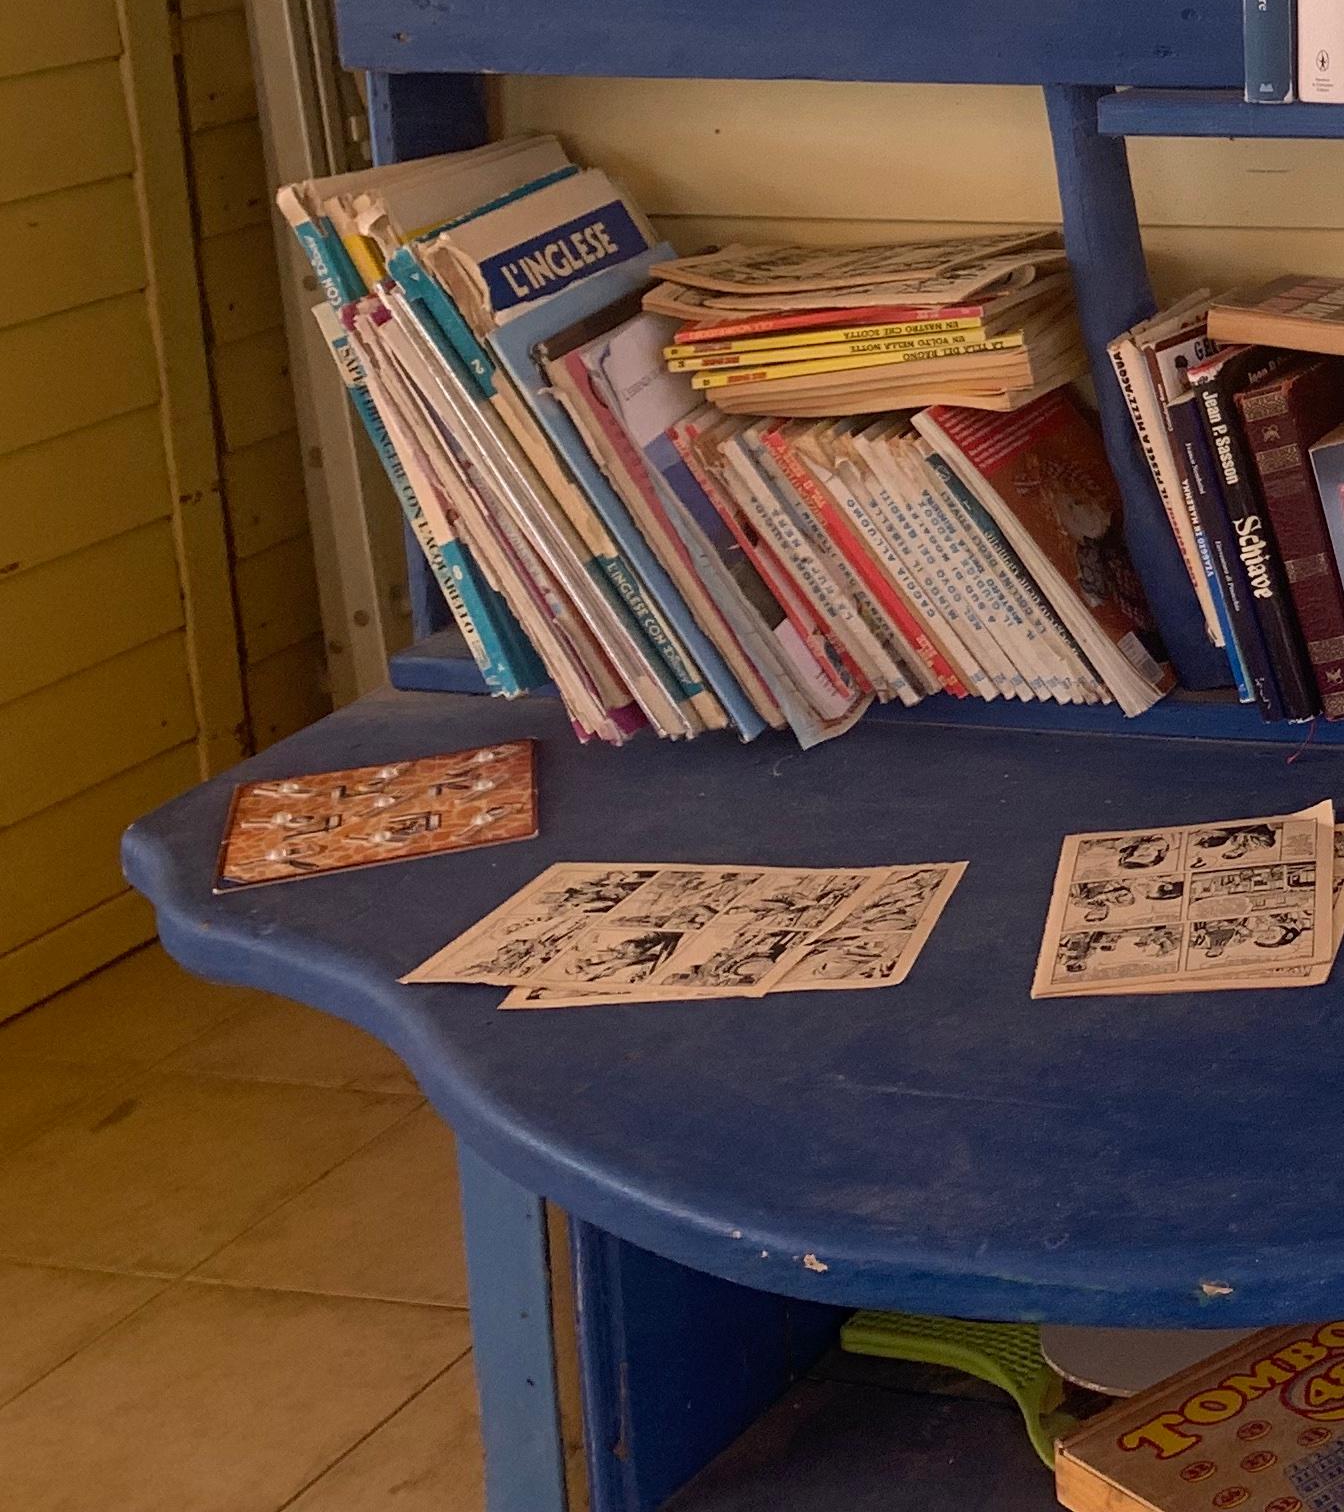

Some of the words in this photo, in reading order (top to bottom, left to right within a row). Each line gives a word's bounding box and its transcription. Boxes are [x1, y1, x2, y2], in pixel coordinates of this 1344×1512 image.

[500, 220, 620, 299] L'INGLESE
[1203, 390, 1221, 425] Jean
[1212, 426, 1228, 441] P.
[1214, 439, 1239, 485] Sasson
[1233, 515, 1275, 599] Schiave
